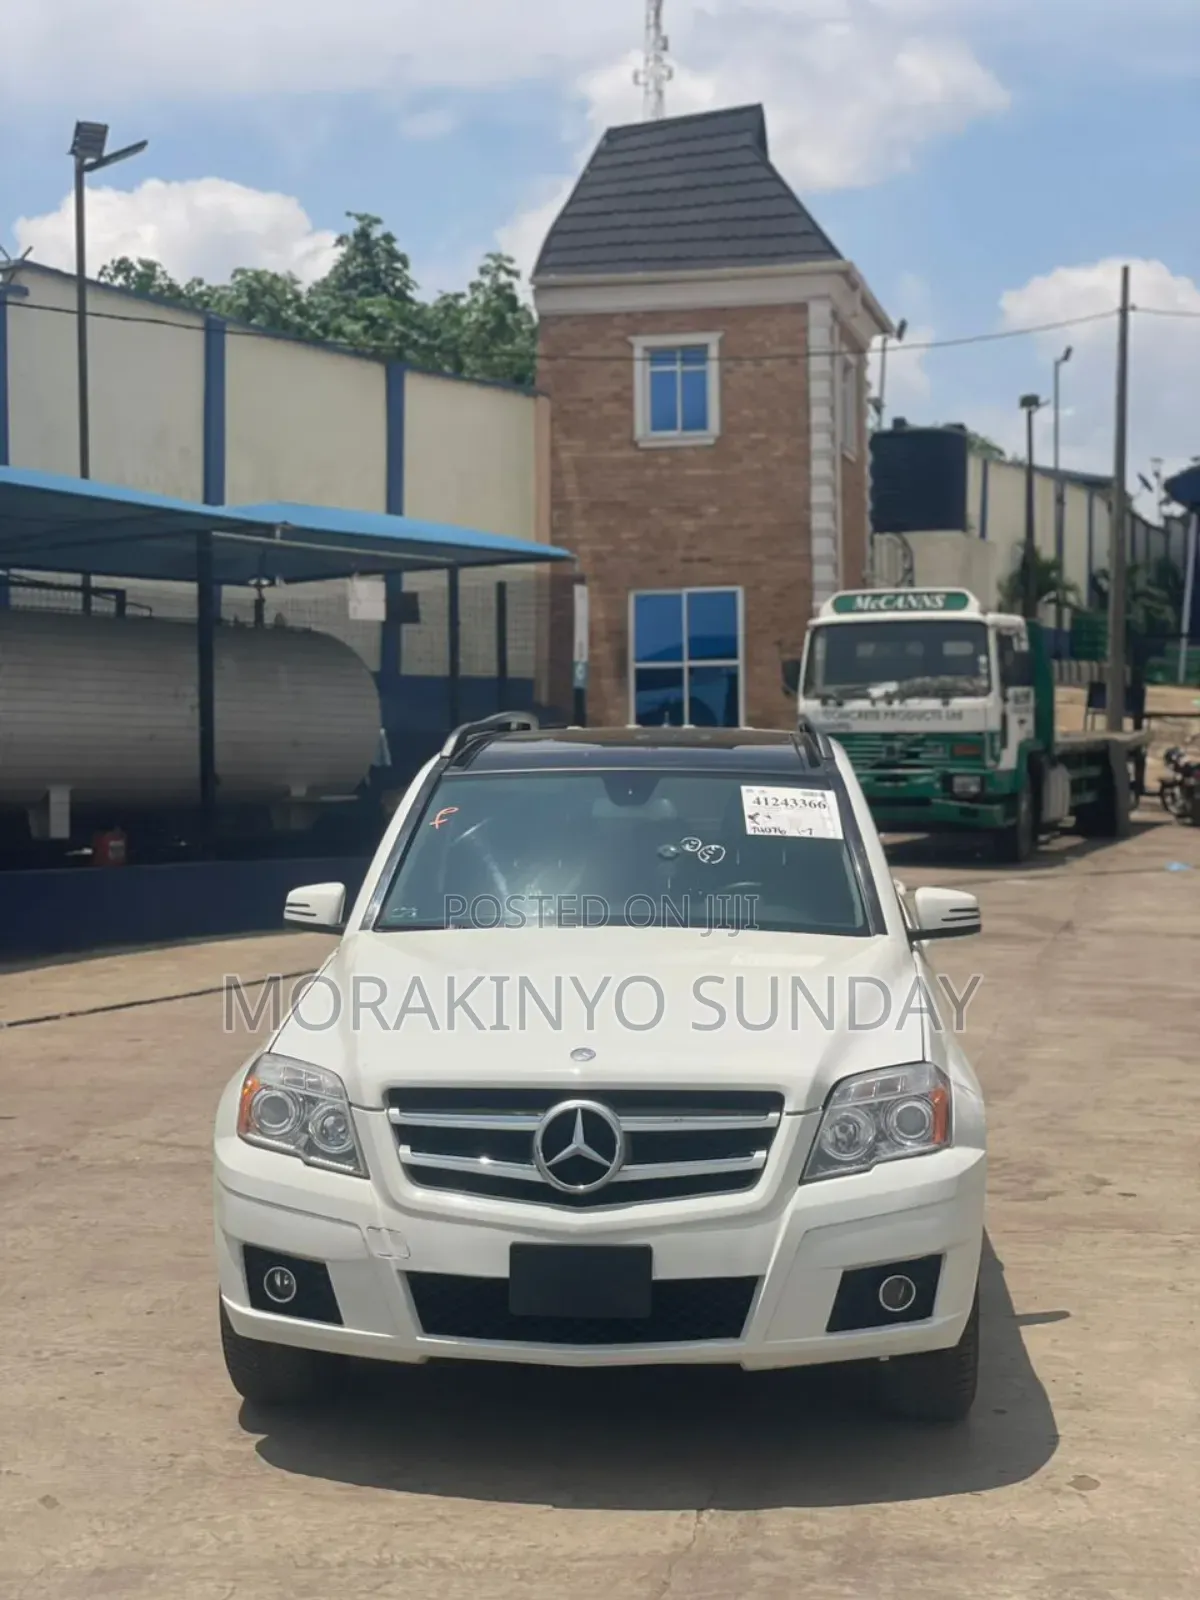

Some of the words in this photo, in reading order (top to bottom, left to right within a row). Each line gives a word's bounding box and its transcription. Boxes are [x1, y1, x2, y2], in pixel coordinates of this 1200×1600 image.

[852, 594, 947, 611] McCANNS
[883, 709, 943, 721] PRODUCTS
[752, 796, 827, 810] 41243366
